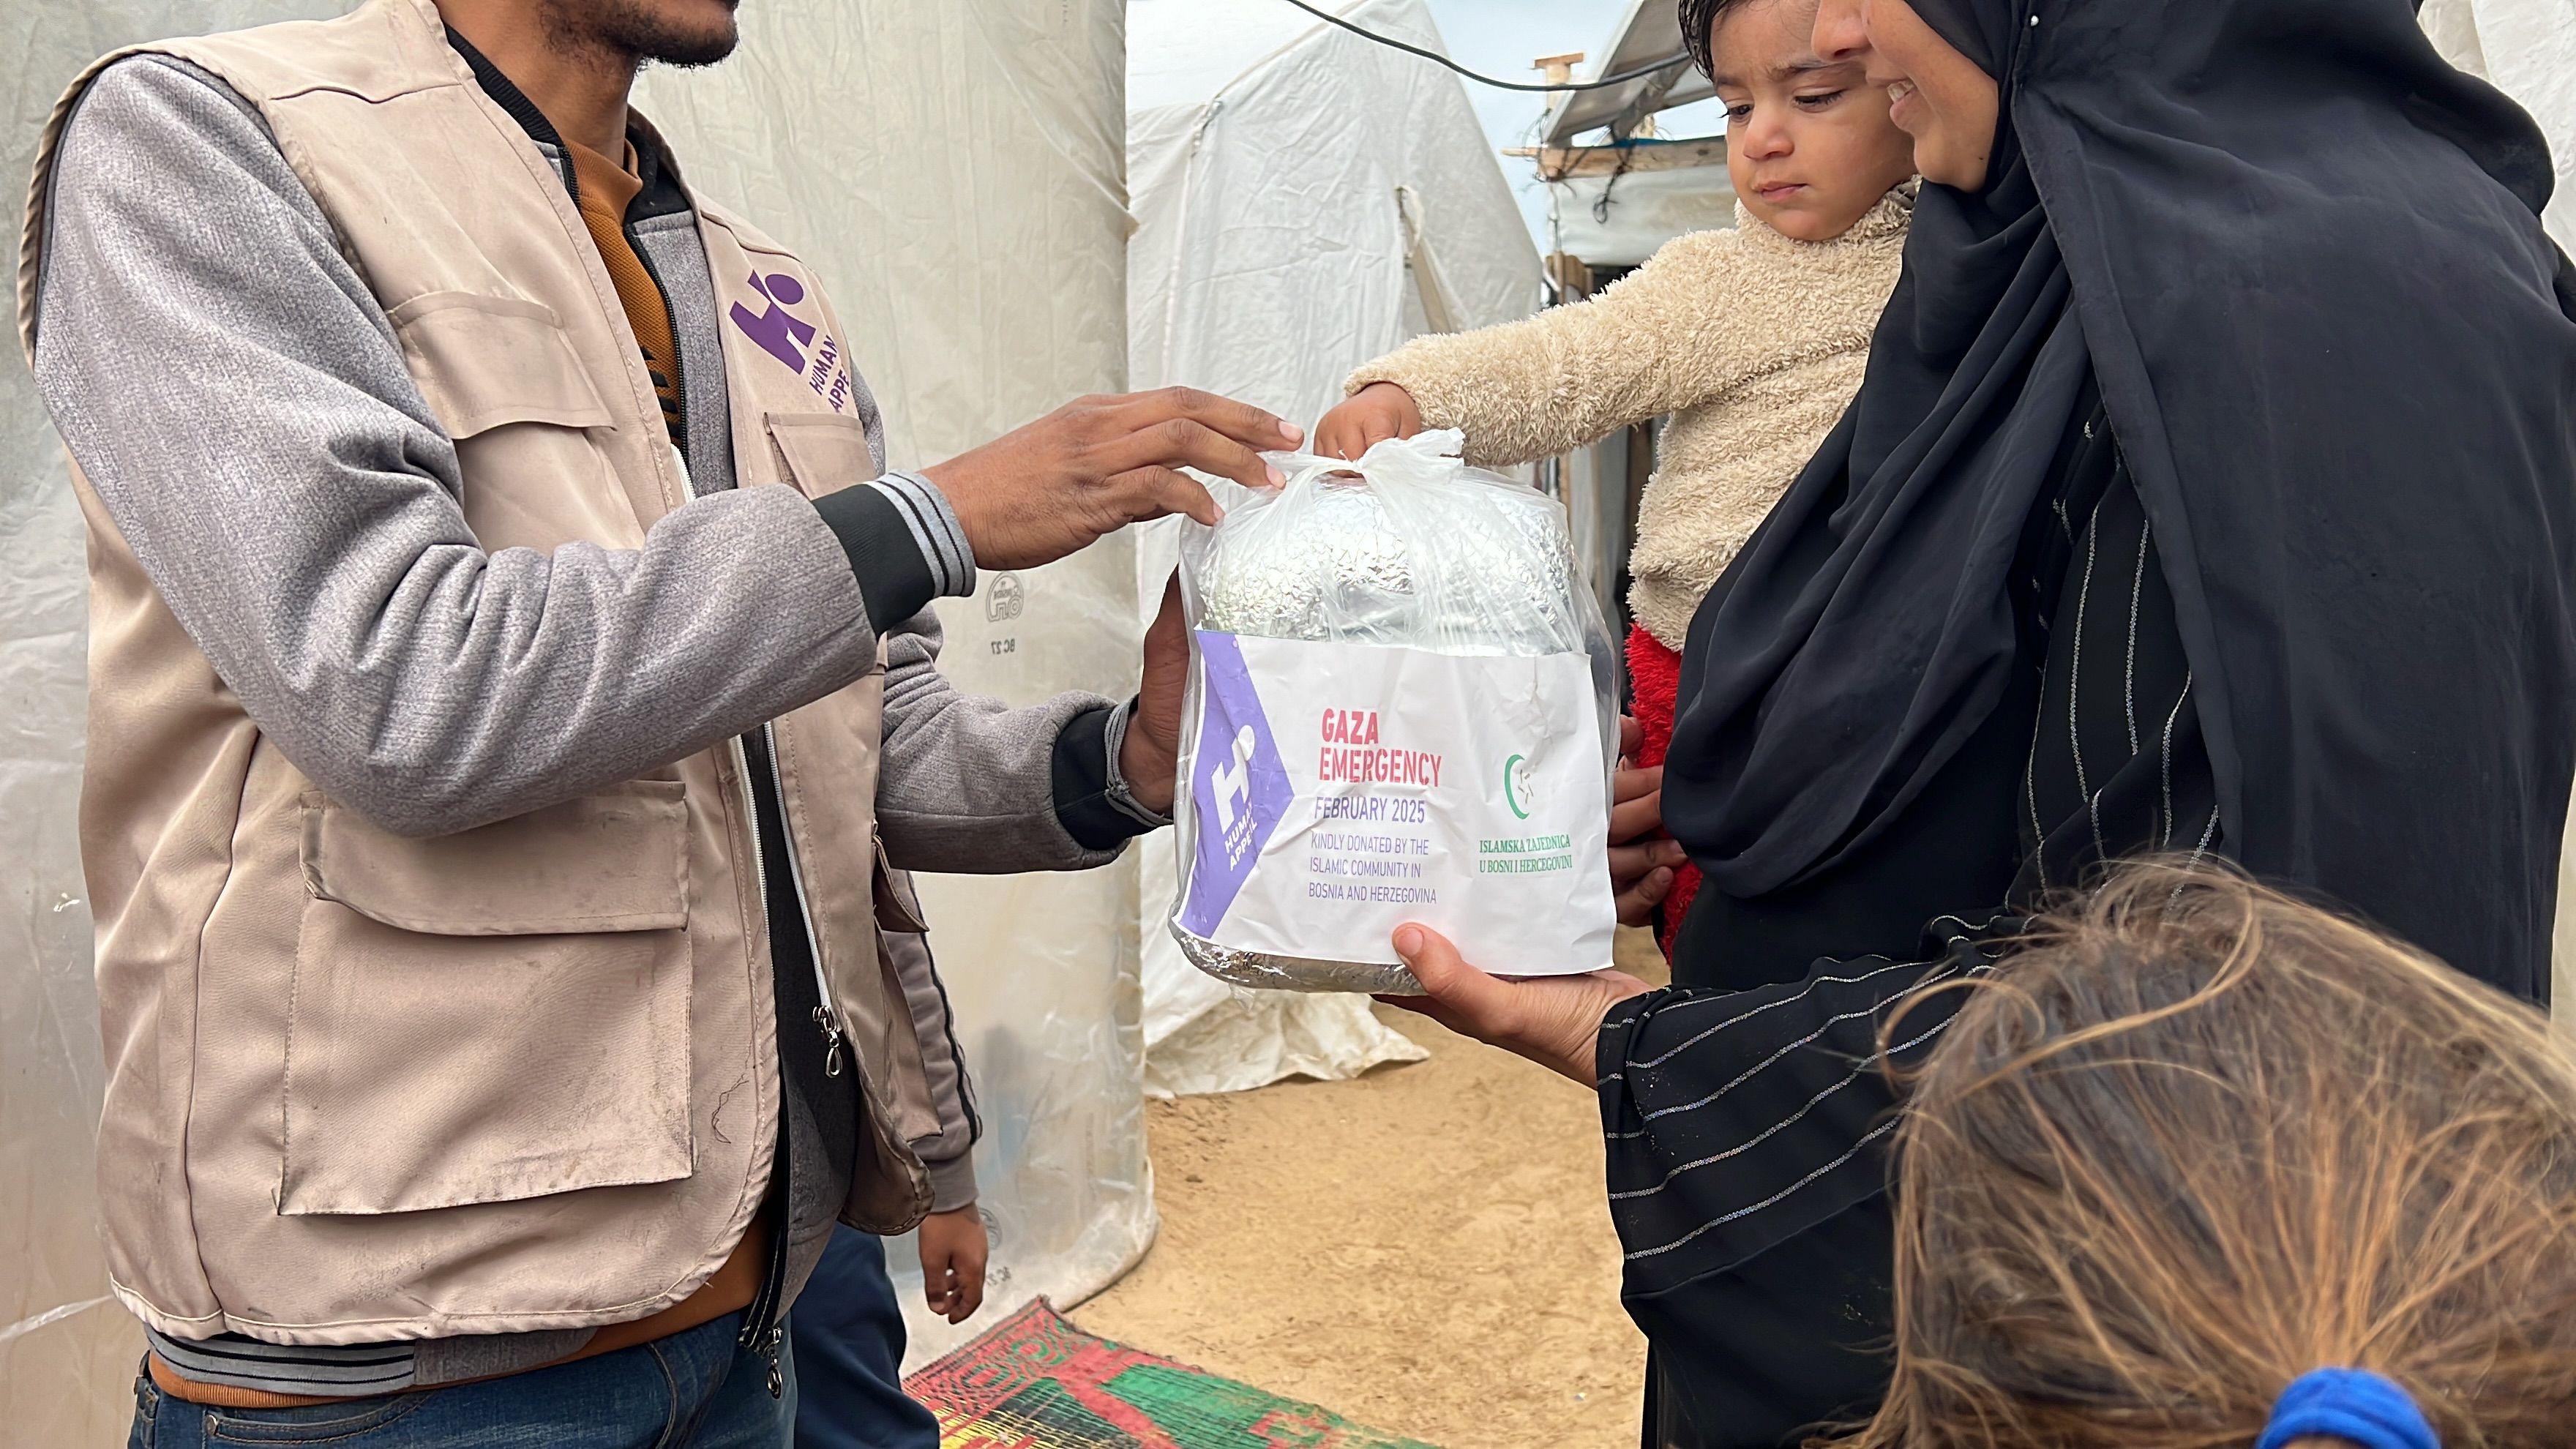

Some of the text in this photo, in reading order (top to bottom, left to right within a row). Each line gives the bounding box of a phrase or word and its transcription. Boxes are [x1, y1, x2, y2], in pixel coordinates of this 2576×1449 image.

[809, 334, 837, 396] HUMAN
[828, 369, 850, 413] APPE
[1322, 708, 1379, 745] GAZA
[1319, 747, 1442, 787] EMERGENCY
[1314, 796, 1425, 823] FEBRUARY 2025
[1311, 833, 1429, 855] KINDLY DONATED BY THE
[1480, 834, 1570, 853] ISLAMSKA ZAJEDNICA
[1310, 857, 1421, 878] ISLAMIC COMMUNITY IN
[1480, 855, 1573, 873] U BOSNI I HERCEGOVINI
[1308, 882, 1437, 904] BOSNIA AND HERZEGOVINA
